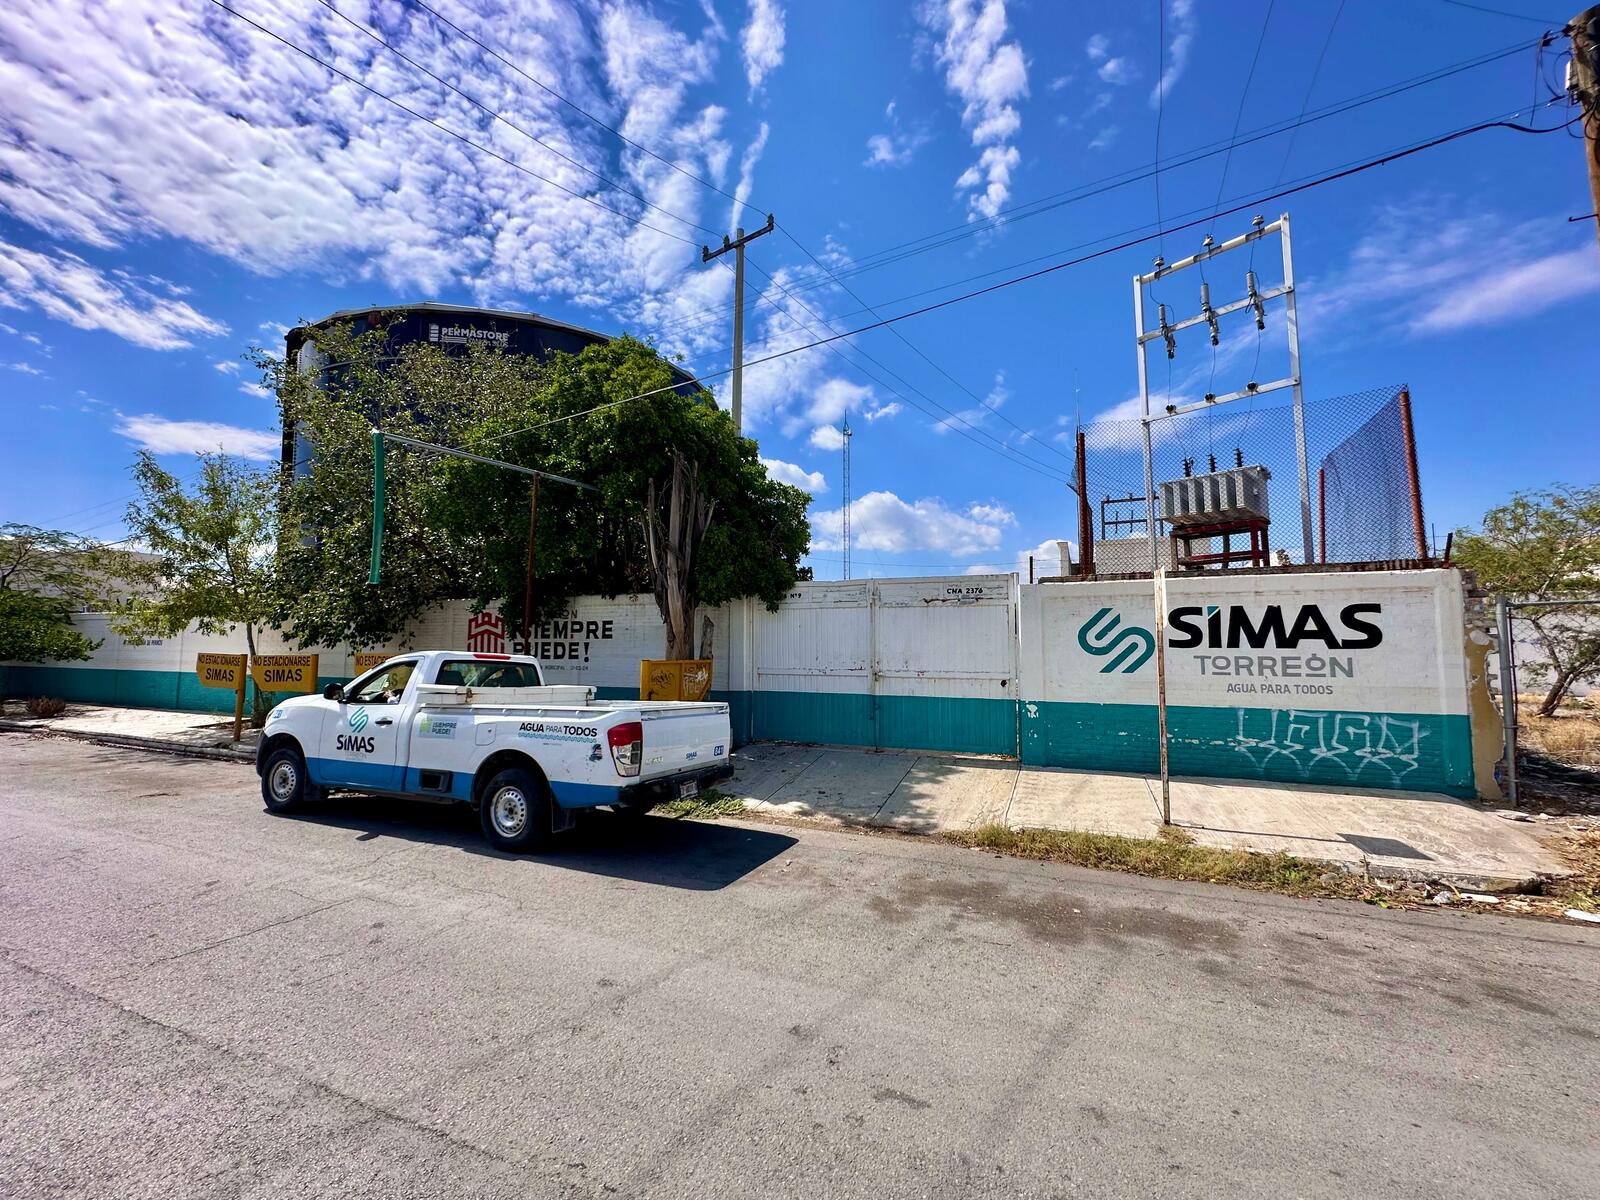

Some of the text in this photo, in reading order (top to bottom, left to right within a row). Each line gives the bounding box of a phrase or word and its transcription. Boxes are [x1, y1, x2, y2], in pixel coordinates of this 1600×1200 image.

[441, 327, 509, 342] PERMASTORE
[1168, 603, 1383, 649] SIMAS
[512, 641, 590, 663] PUEDE!
[205, 654, 241, 667] ESTACIONARSE
[254, 656, 311, 667] NO ESTACIONARSE
[205, 667, 235, 682] SIMAS
[264, 668, 303, 682] SIMAS
[1226, 683, 1334, 695] AGUA PARA TODOS
[519, 722, 598, 737] AGUA PARA TODOS
[336, 734, 375, 754] SIMAS
